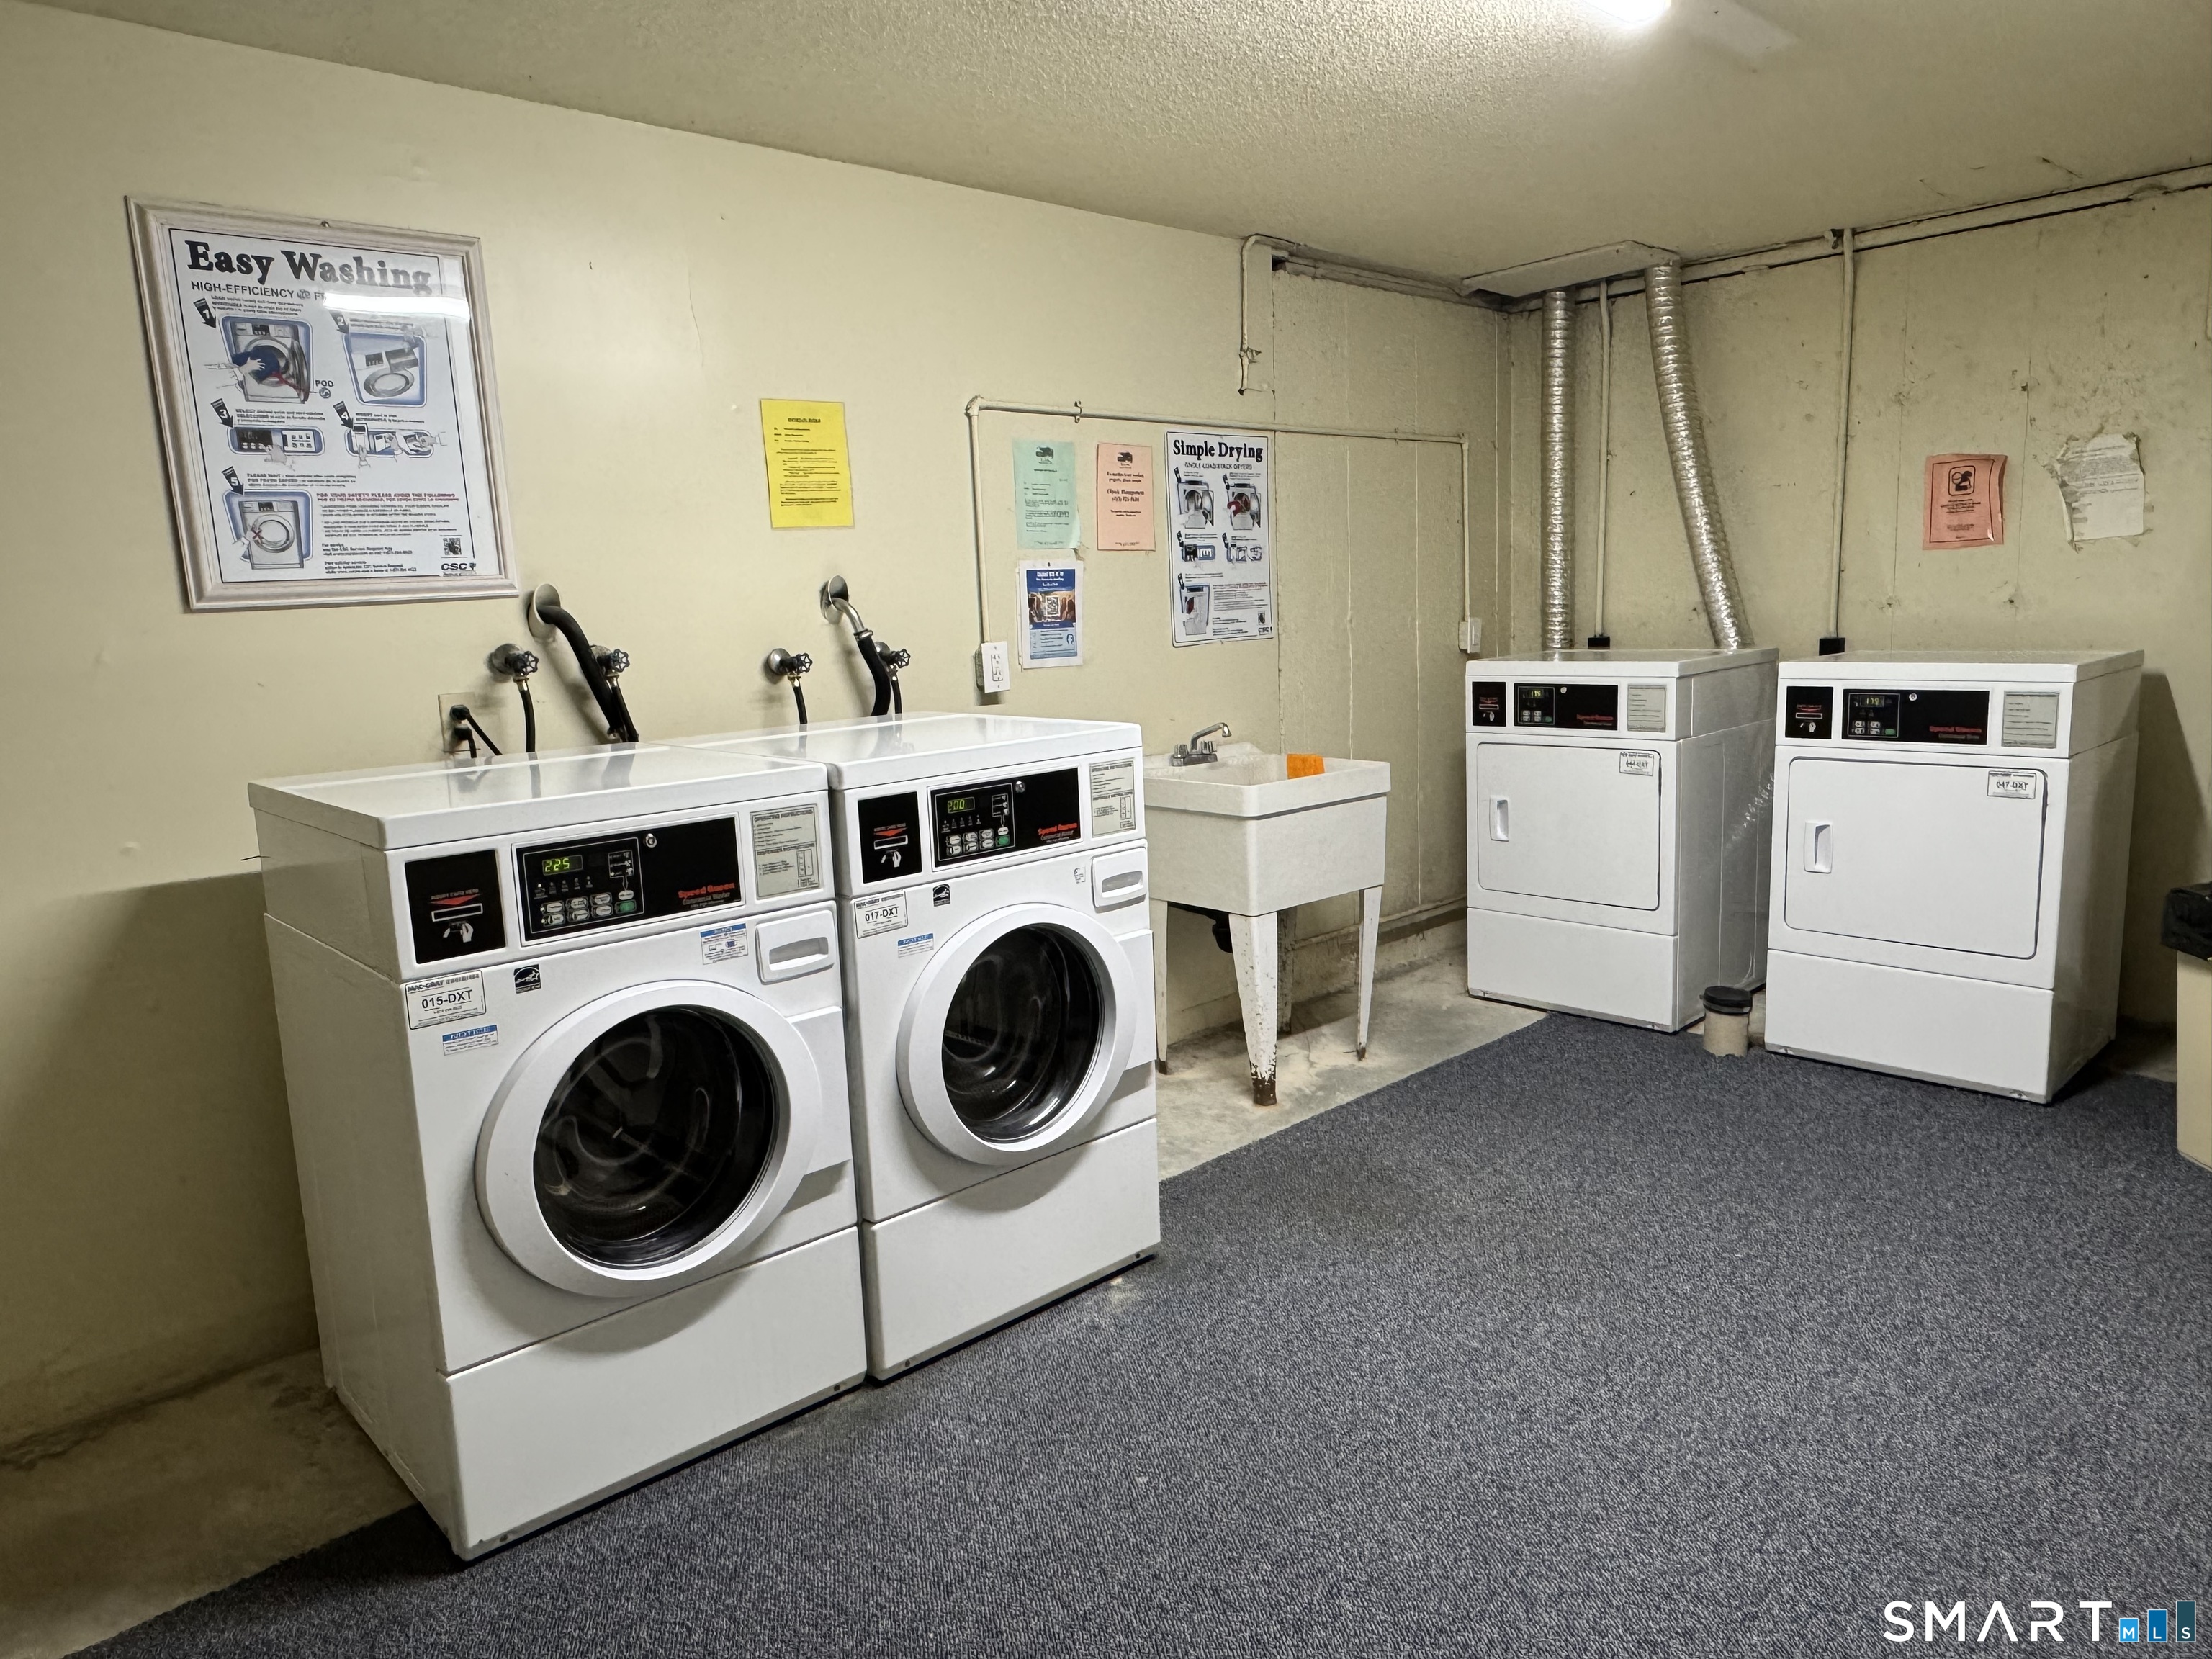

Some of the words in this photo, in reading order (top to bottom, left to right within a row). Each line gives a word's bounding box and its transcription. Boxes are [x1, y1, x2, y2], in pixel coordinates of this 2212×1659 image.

[184, 240, 274, 285] Easy
[281, 250, 432, 295] Washing
[191, 280, 294, 300] HIGH-EFFICIENCY
[218, 409, 228, 418] 3
[341, 411, 349, 421] 4
[1173, 439, 1215, 461] Simple
[1218, 442, 1263, 462] Drying
[230, 477, 239, 486] 5
[441, 562, 467, 571] CSC
[544, 858, 570, 873] 225
[865, 907, 899, 922] 017-DXT
[421, 989, 473, 1009] 015-DXT
